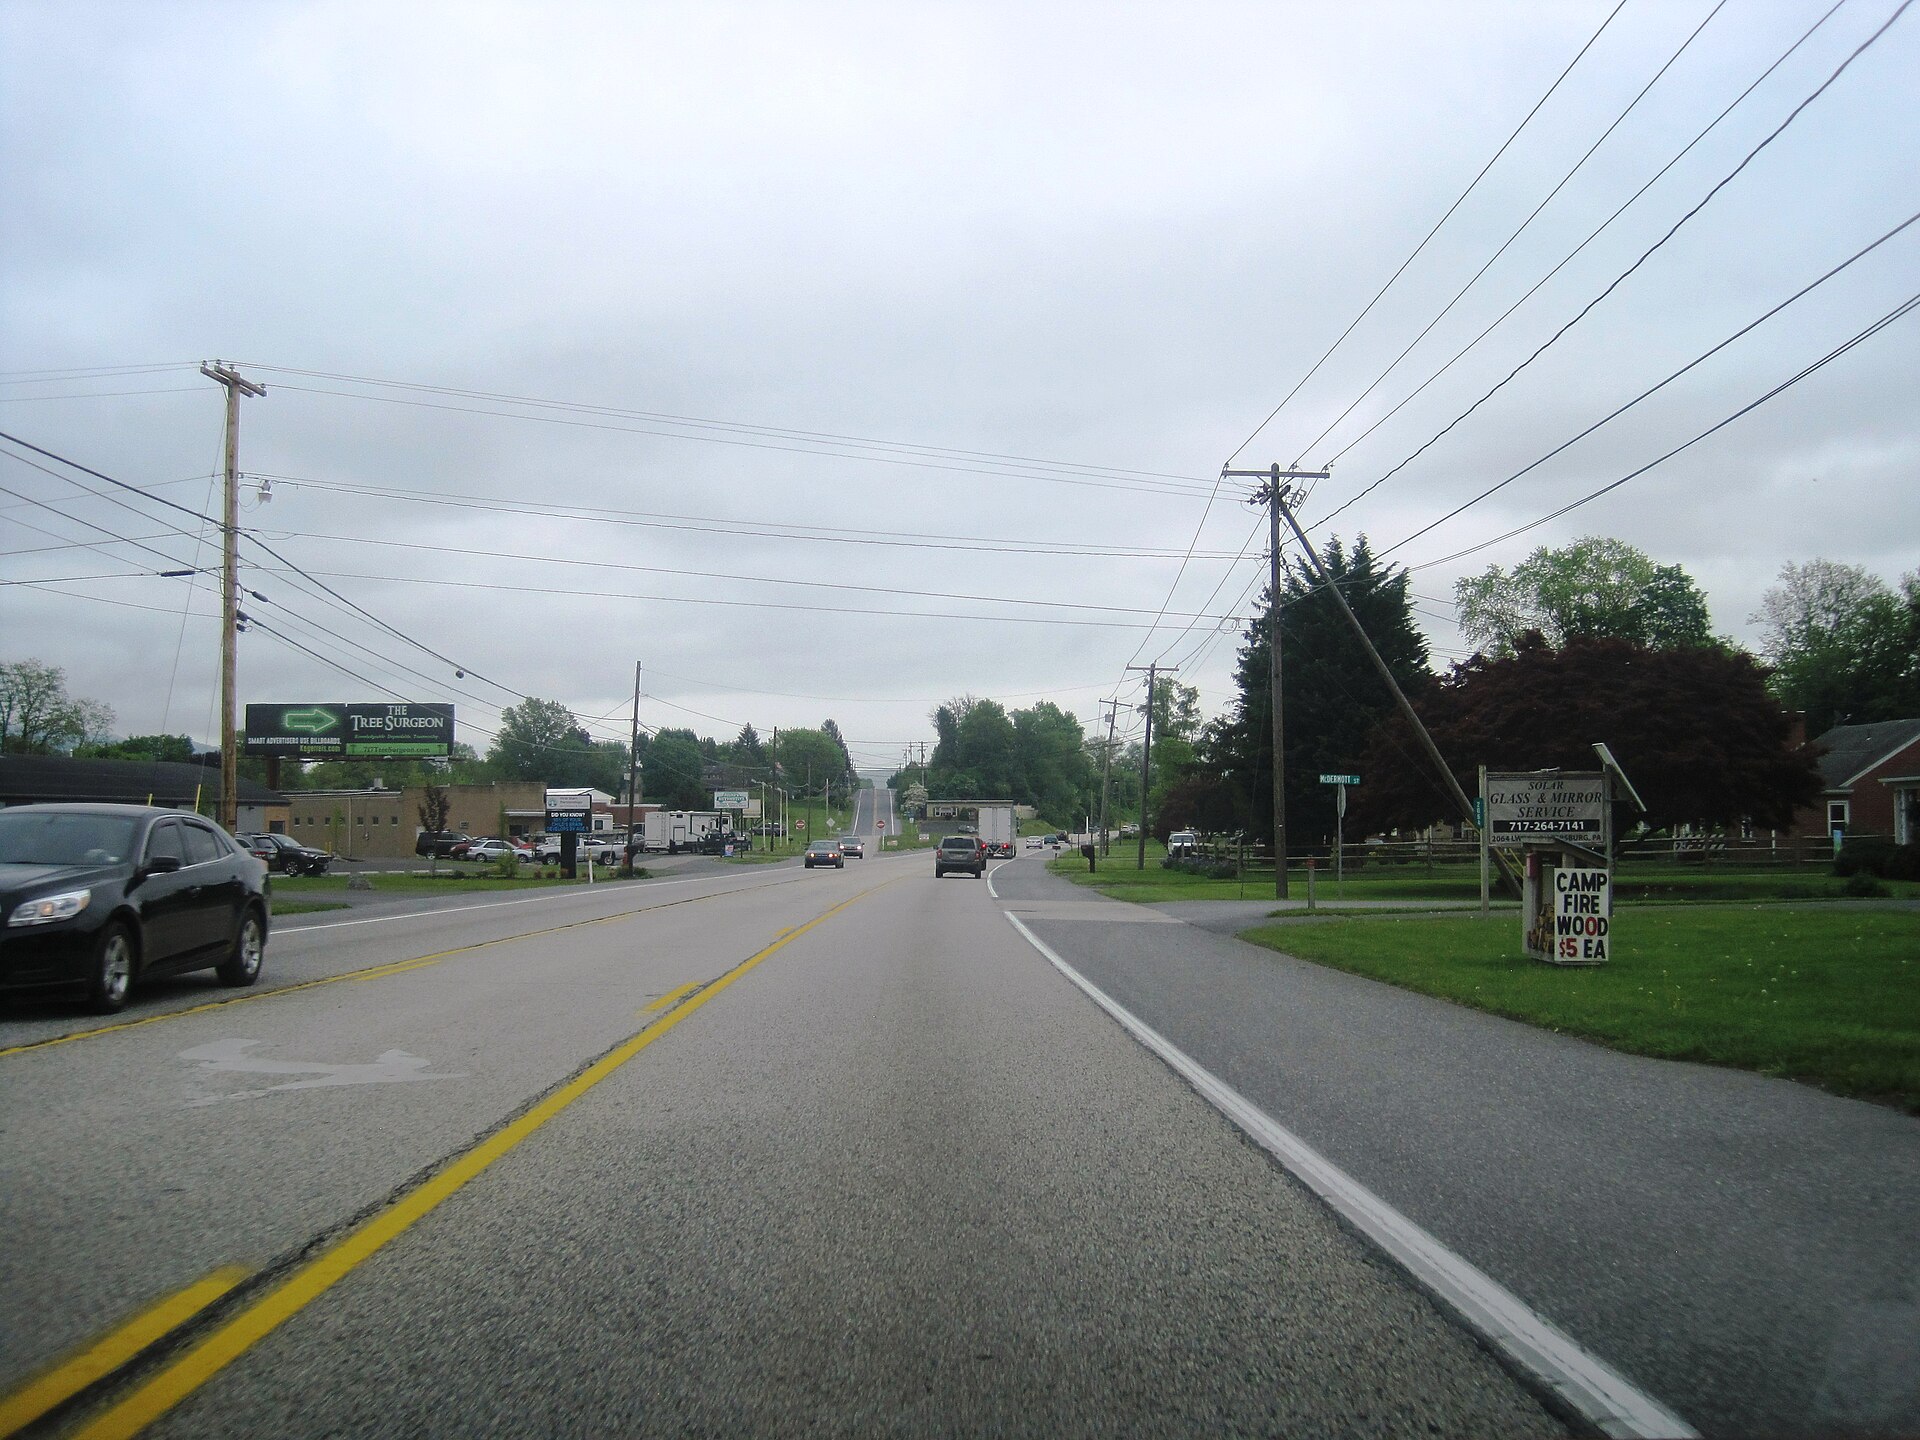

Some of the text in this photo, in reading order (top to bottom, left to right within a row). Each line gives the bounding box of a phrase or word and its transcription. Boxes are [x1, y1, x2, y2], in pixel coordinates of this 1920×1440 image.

[387, 705, 407, 716] THE
[350, 714, 444, 732] TREE SURGEON
[248, 737, 266, 745] SMART
[266, 737, 299, 745] ADVERTISERS
[299, 737, 310, 745] USE
[1528, 781, 1564, 791] SOLAR
[1490, 792, 1603, 804] GLASS & MIRROR
[1517, 806, 1576, 818] SERVICE
[1509, 821, 1585, 831] 717-264-7141
[1492, 835, 1510, 843] 2064
[1556, 872, 1608, 892] CAMP
[1563, 894, 1600, 914] FIRE
[1557, 916, 1608, 936] WOOD
[1559, 938, 1606, 959] $5 EA
